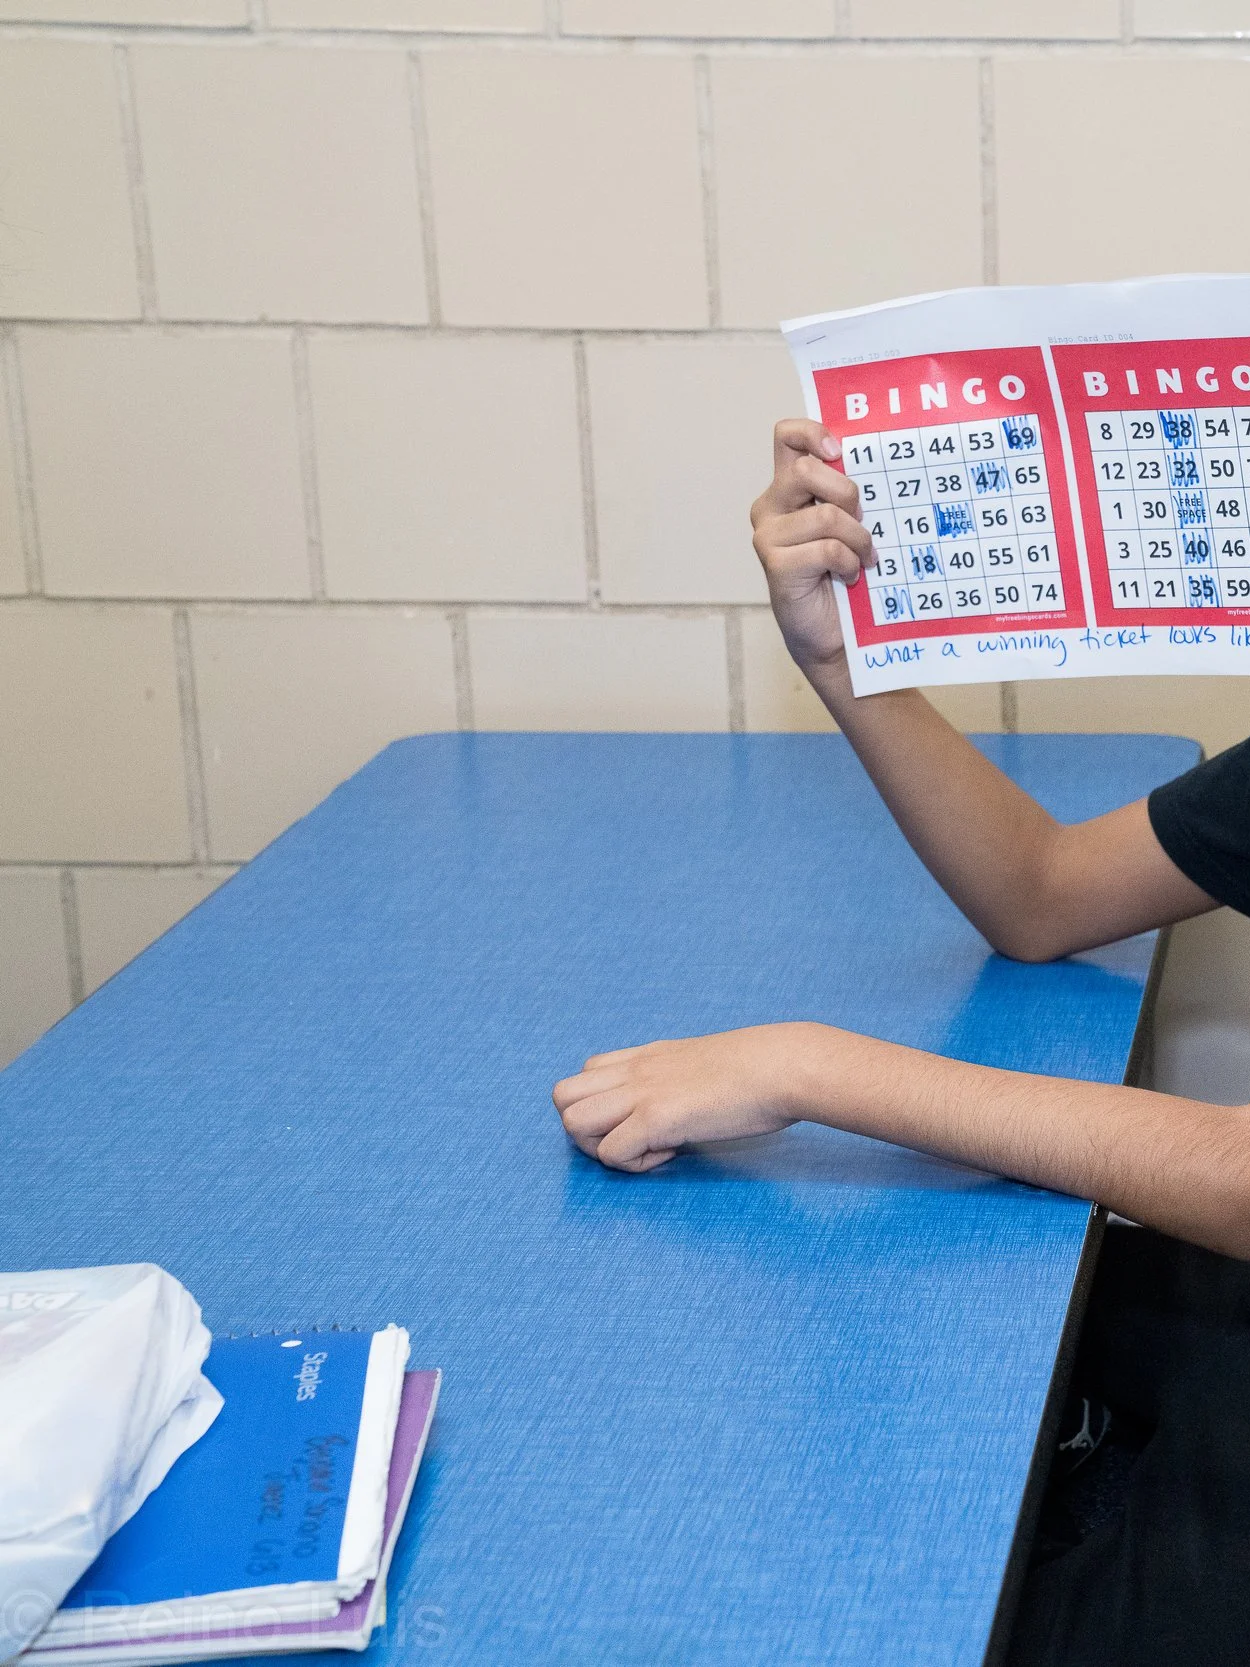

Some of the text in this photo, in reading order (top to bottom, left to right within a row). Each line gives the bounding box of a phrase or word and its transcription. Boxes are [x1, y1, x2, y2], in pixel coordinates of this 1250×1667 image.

[1048, 335, 1073, 344] Bingo
[1078, 335, 1099, 343] Card
[1118, 333, 1134, 341] 004
[868, 352, 880, 360] ID
[845, 375, 1026, 421] BINGO
[1101, 423, 1113, 440] 8
[1130, 421, 1155, 439] 29
[1168, 420, 1192, 438] 38
[1205, 419, 1230, 437] 54
[850, 427, 1034, 464] 11 23 44 53 69
[1101, 462, 1125, 480] 12
[1137, 462, 1161, 479] 23
[1173, 461, 1199, 479] 32
[1210, 459, 1235, 478] 50
[864, 466, 1041, 501] 5 27 38 47 65
[1113, 502, 1123, 519] 1
[1143, 501, 1167, 518] 30
[1216, 500, 1241, 517] 48
[1179, 498, 1202, 507] FREE
[871, 506, 1047, 538] 4 16 56 63
[943, 510, 967, 520] FREE
[1177, 509, 1206, 518] SPACE
[940, 521, 973, 532] SPACE
[1118, 541, 1130, 559] 3
[1149, 541, 1173, 558] 25
[1185, 540, 1209, 558] 40
[1222, 539, 1246, 557] 46
[875, 544, 1050, 577] 13 18 40 55 61
[885, 584, 1058, 613] 9 26 36 50 74
[1118, 581, 1140, 598] 11
[1154, 580, 1176, 597] 21
[1190, 580, 1214, 598] 35
[1227, 579, 1250, 597] 59
[996, 613, 1067, 622] myfreebingocards.com
[942, 642, 960, 658] a
[978, 631, 1067, 667] winning
[1080, 623, 1152, 650] ticket
[293, 1351, 328, 1402] Staples
